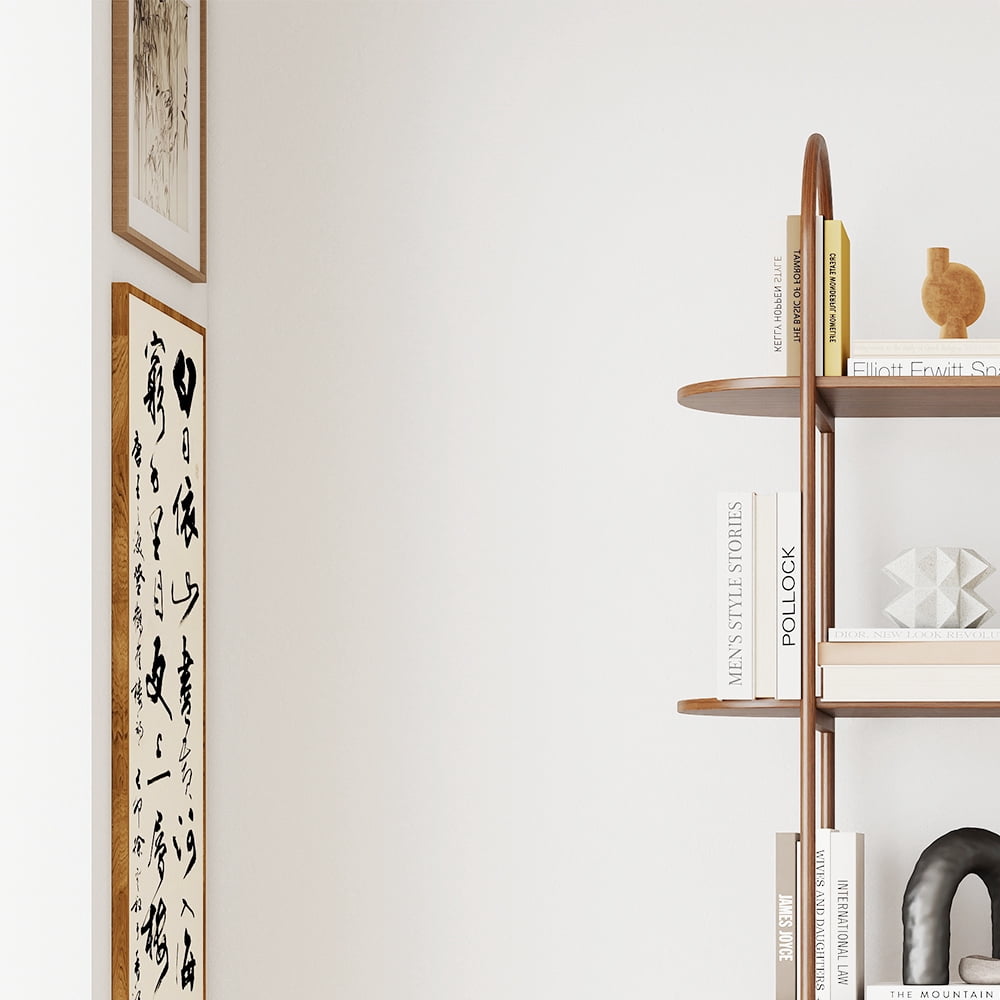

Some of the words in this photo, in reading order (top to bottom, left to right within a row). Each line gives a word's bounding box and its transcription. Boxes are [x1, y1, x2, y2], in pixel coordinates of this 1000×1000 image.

[853, 361, 903, 376] Elliott
[910, 361, 964, 376] Erwitt
[728, 501, 742, 573] STORIES
[728, 577, 742, 631] STYLE
[781, 546, 796, 646] POLLOCK
[874, 630, 902, 639] NEW
[906, 630, 942, 639] LOOK
[728, 634, 742, 686] MEN'S
[815, 850, 825, 887] WIVES
[779, 894, 793, 928] JAMES
[815, 890, 825, 916] AND
[837, 880, 849, 961] INTERNATIONAL
[779, 930, 793, 962] JOYCE
[815, 919, 825, 991] DAUGHTERS
[837, 965, 849, 985] LAW
[890, 990, 913, 999] THE
[920, 990, 994, 999] MOUNTAIN
